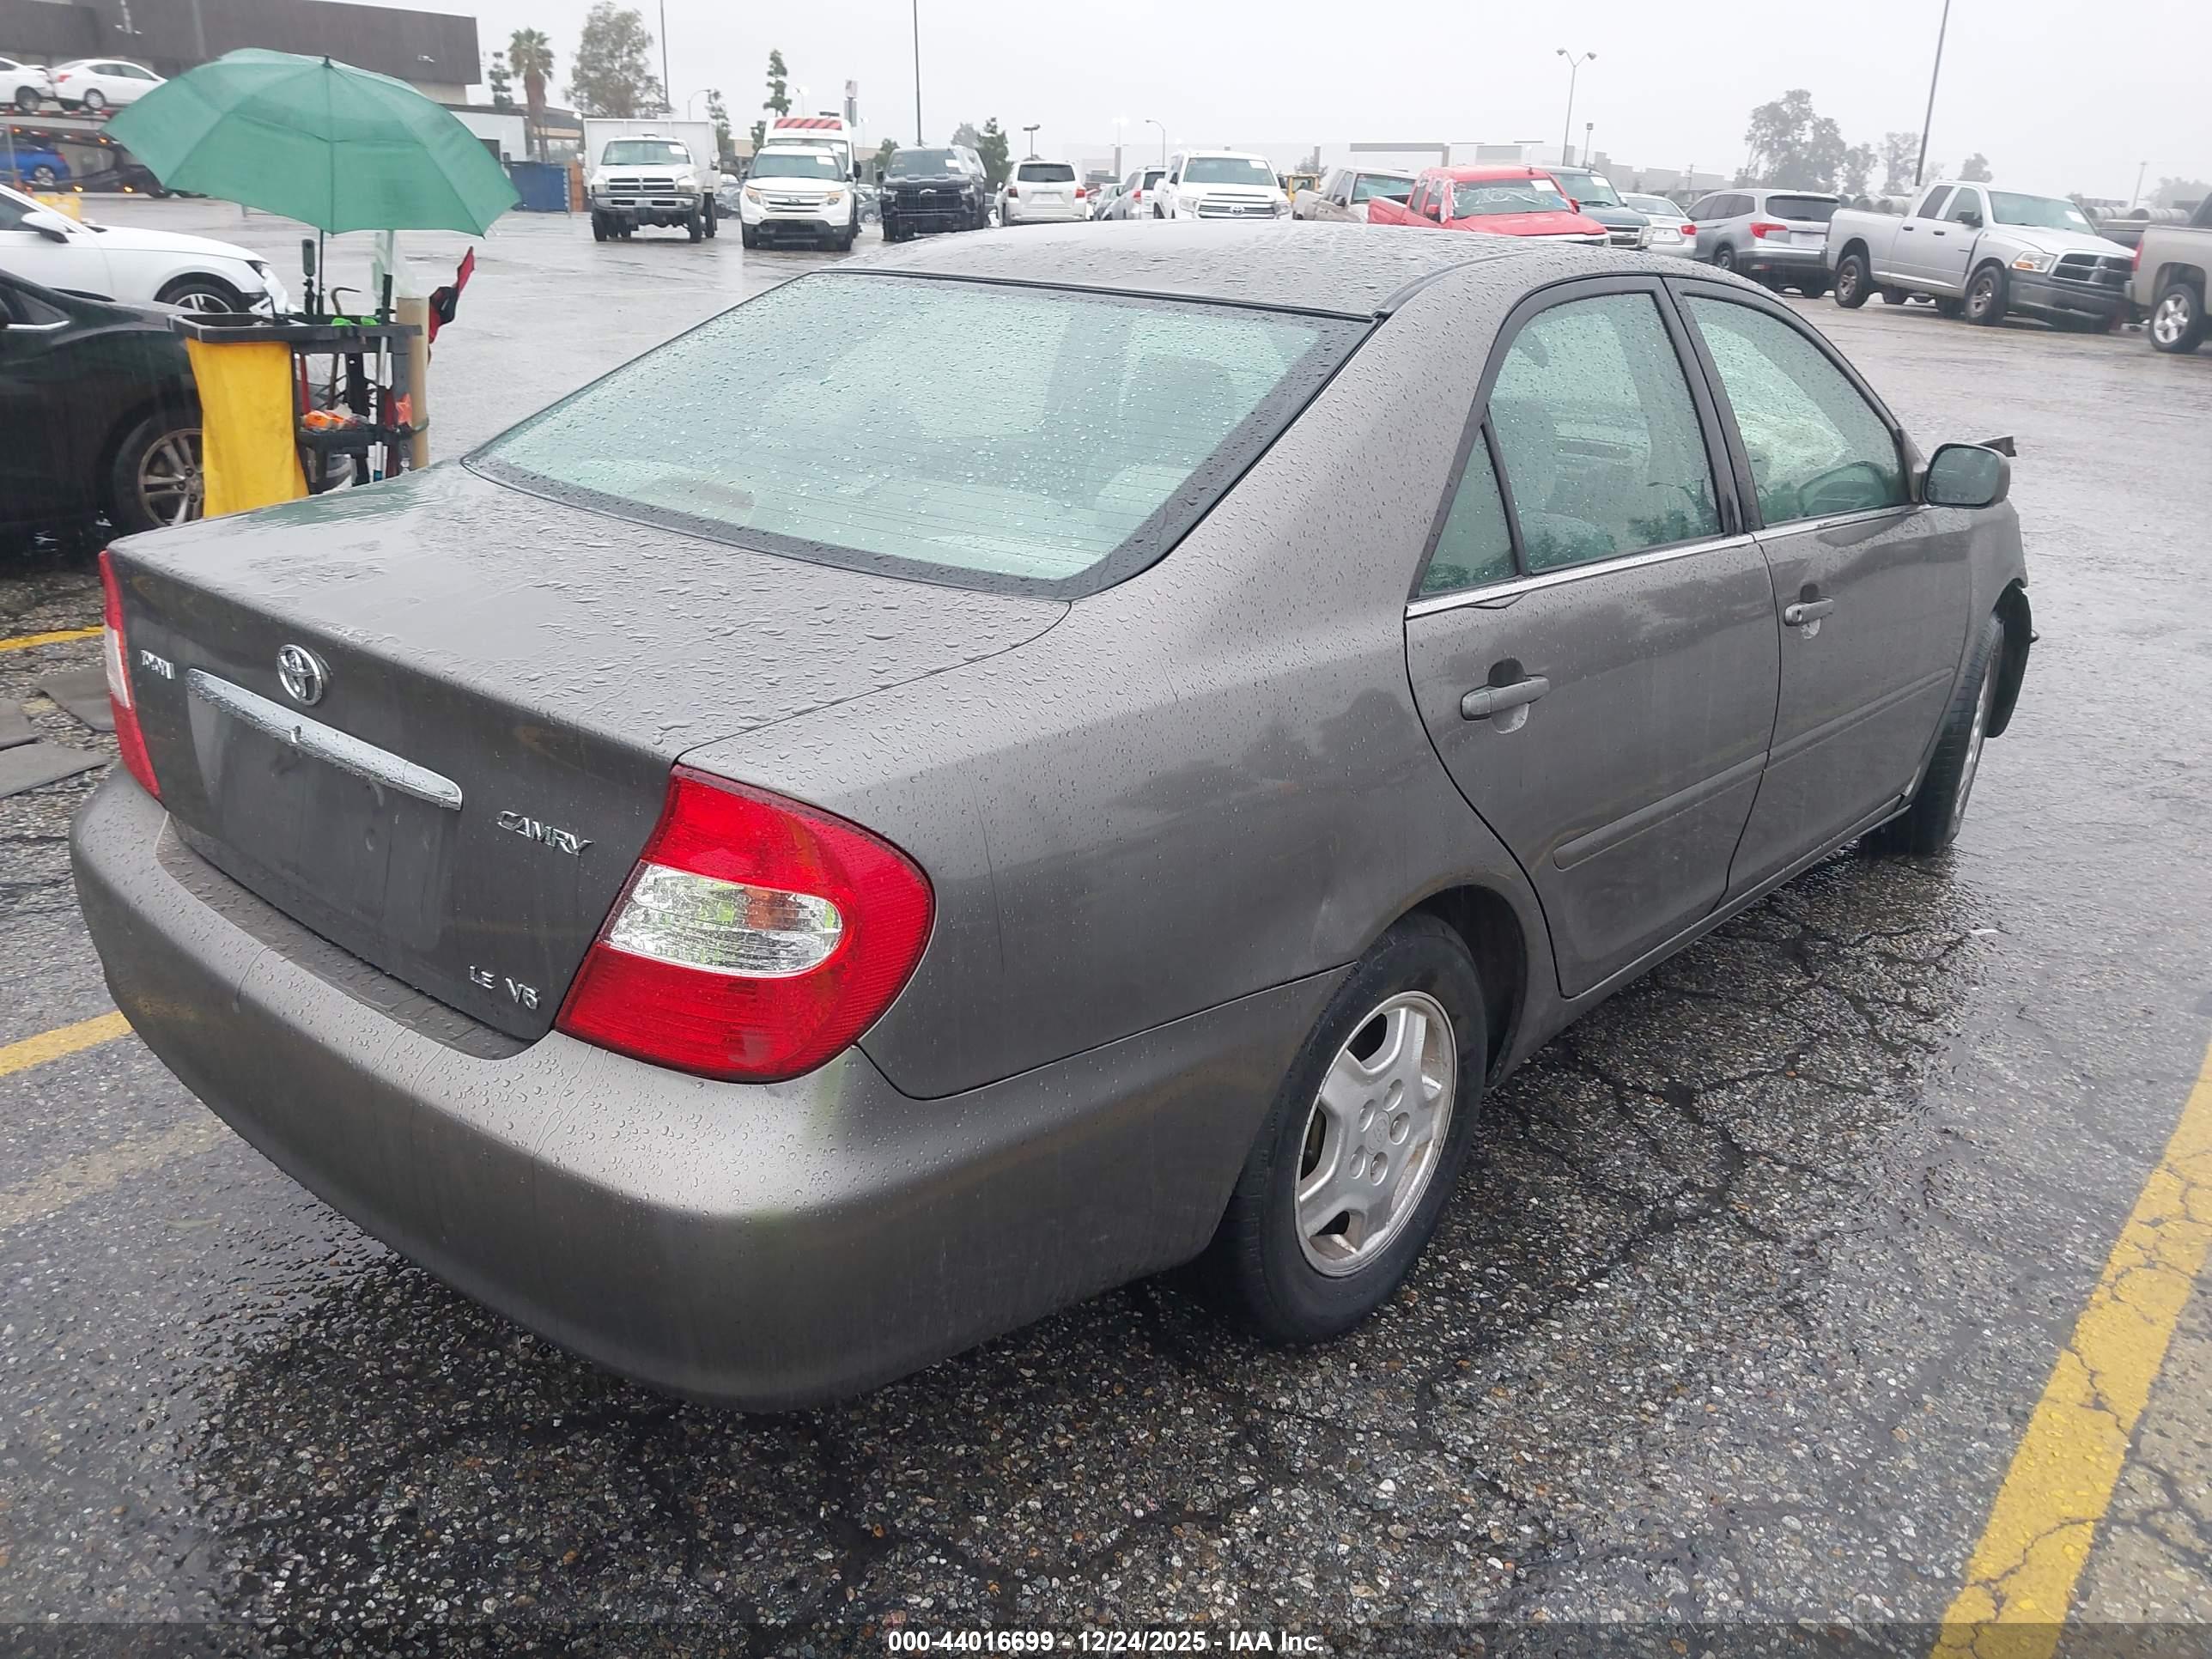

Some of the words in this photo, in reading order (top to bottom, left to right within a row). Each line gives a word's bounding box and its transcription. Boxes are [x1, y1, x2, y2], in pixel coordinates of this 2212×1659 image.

[497, 810, 595, 857] CAMRY
[469, 965, 495, 989] LE
[505, 976, 540, 1010] V6
